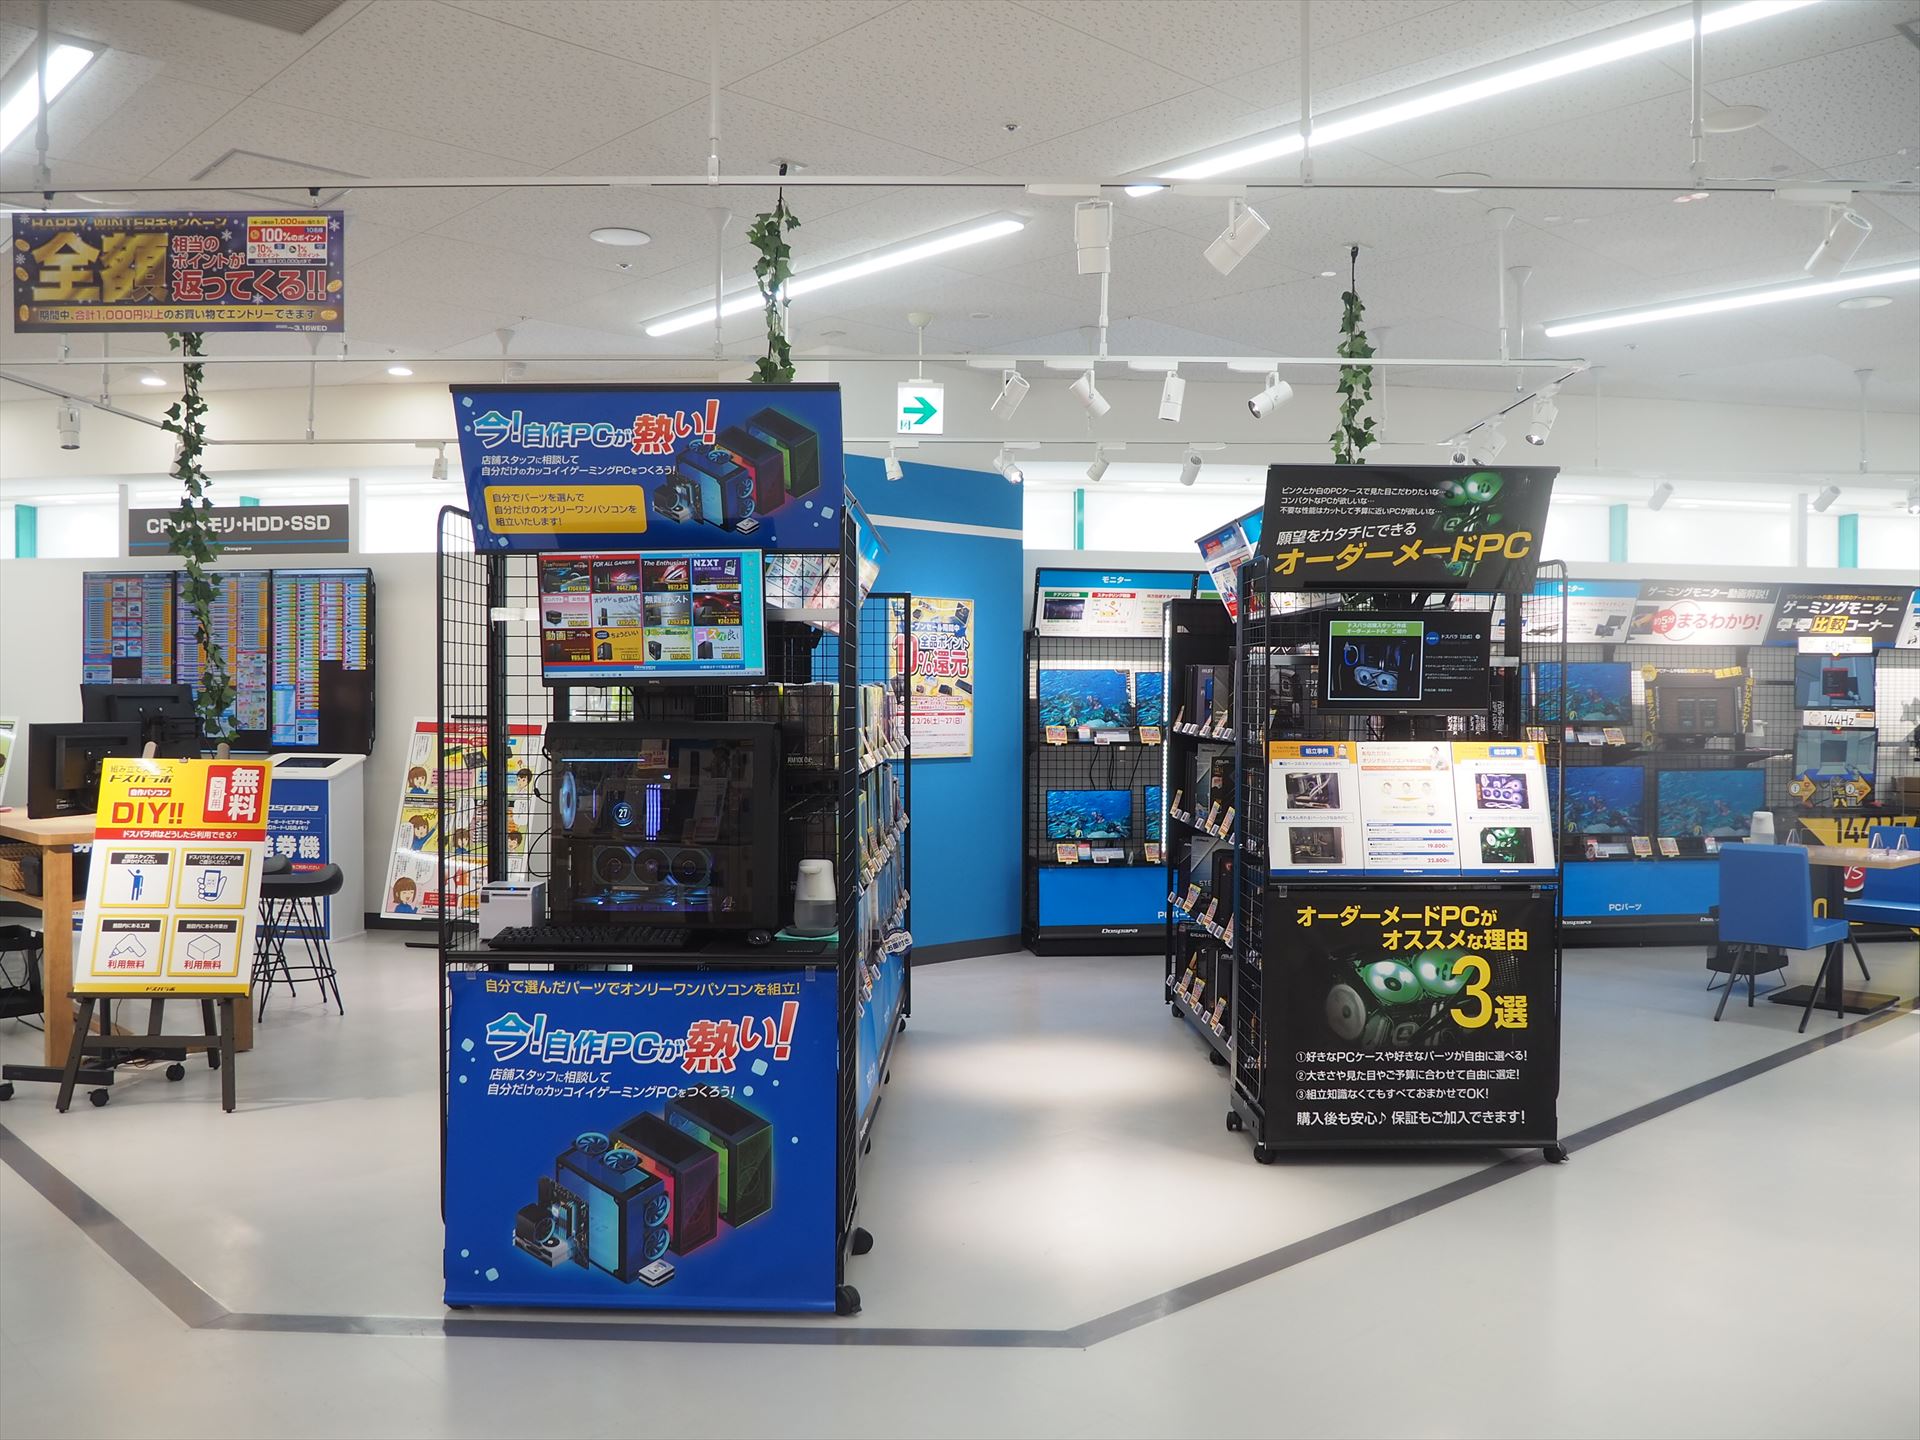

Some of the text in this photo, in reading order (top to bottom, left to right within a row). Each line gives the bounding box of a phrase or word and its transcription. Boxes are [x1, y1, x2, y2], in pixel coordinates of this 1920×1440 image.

[172, 235, 220, 253] 相当の
[32, 232, 169, 303] 全額
[172, 253, 245, 269] ポイントが
[171, 269, 327, 301] 返ってくる!!
[481, 455, 580, 465] 店舗スタッフに相談して
[481, 465, 676, 477] 自分だけのカッコイイゲーミングPCをつくろう!
[492, 492, 585, 503] 自分でパーツを選んで
[494, 504, 638, 515] 自分だけのオンリーワンパソコンを
[495, 516, 562, 527] 組立いたします!
[1276, 522, 1417, 546] 願望をカタチにできる
[1274, 531, 1532, 576] オーダーメードPC
[693, 559, 720, 567] NZXT
[1102, 576, 1132, 584] モニター
[1783, 601, 1900, 615] ゲーミングモニター
[1677, 613, 1764, 631] まるわかり!
[1812, 616, 1894, 633] 比較コーナー
[920, 633, 970, 650] 全品ポイント
[1824, 714, 1854, 725] 144Hz
[211, 780, 223, 809] ご利用
[227, 767, 260, 822] 無料
[112, 802, 184, 824] DIY!!
[268, 804, 319, 813] ospara
[618, 808, 628, 818] 27
[1608, 903, 1642, 911] PCパーツ
[1297, 905, 1498, 928] オーダーメードPCが
[1383, 929, 1528, 951] オススメな理由
[107, 960, 145, 969] 利用無料
[184, 960, 221, 970] 利用無料
[485, 978, 801, 997] 自分で選んだパーツでオンリーワンパソコンを組立!
[1450, 955, 1528, 1029] 3選
[488, 1068, 612, 1084] 店舗スタッフに相談して
[487, 1084, 735, 1100] 自分だけのカッコイイゲーミングPCをつくろう!
